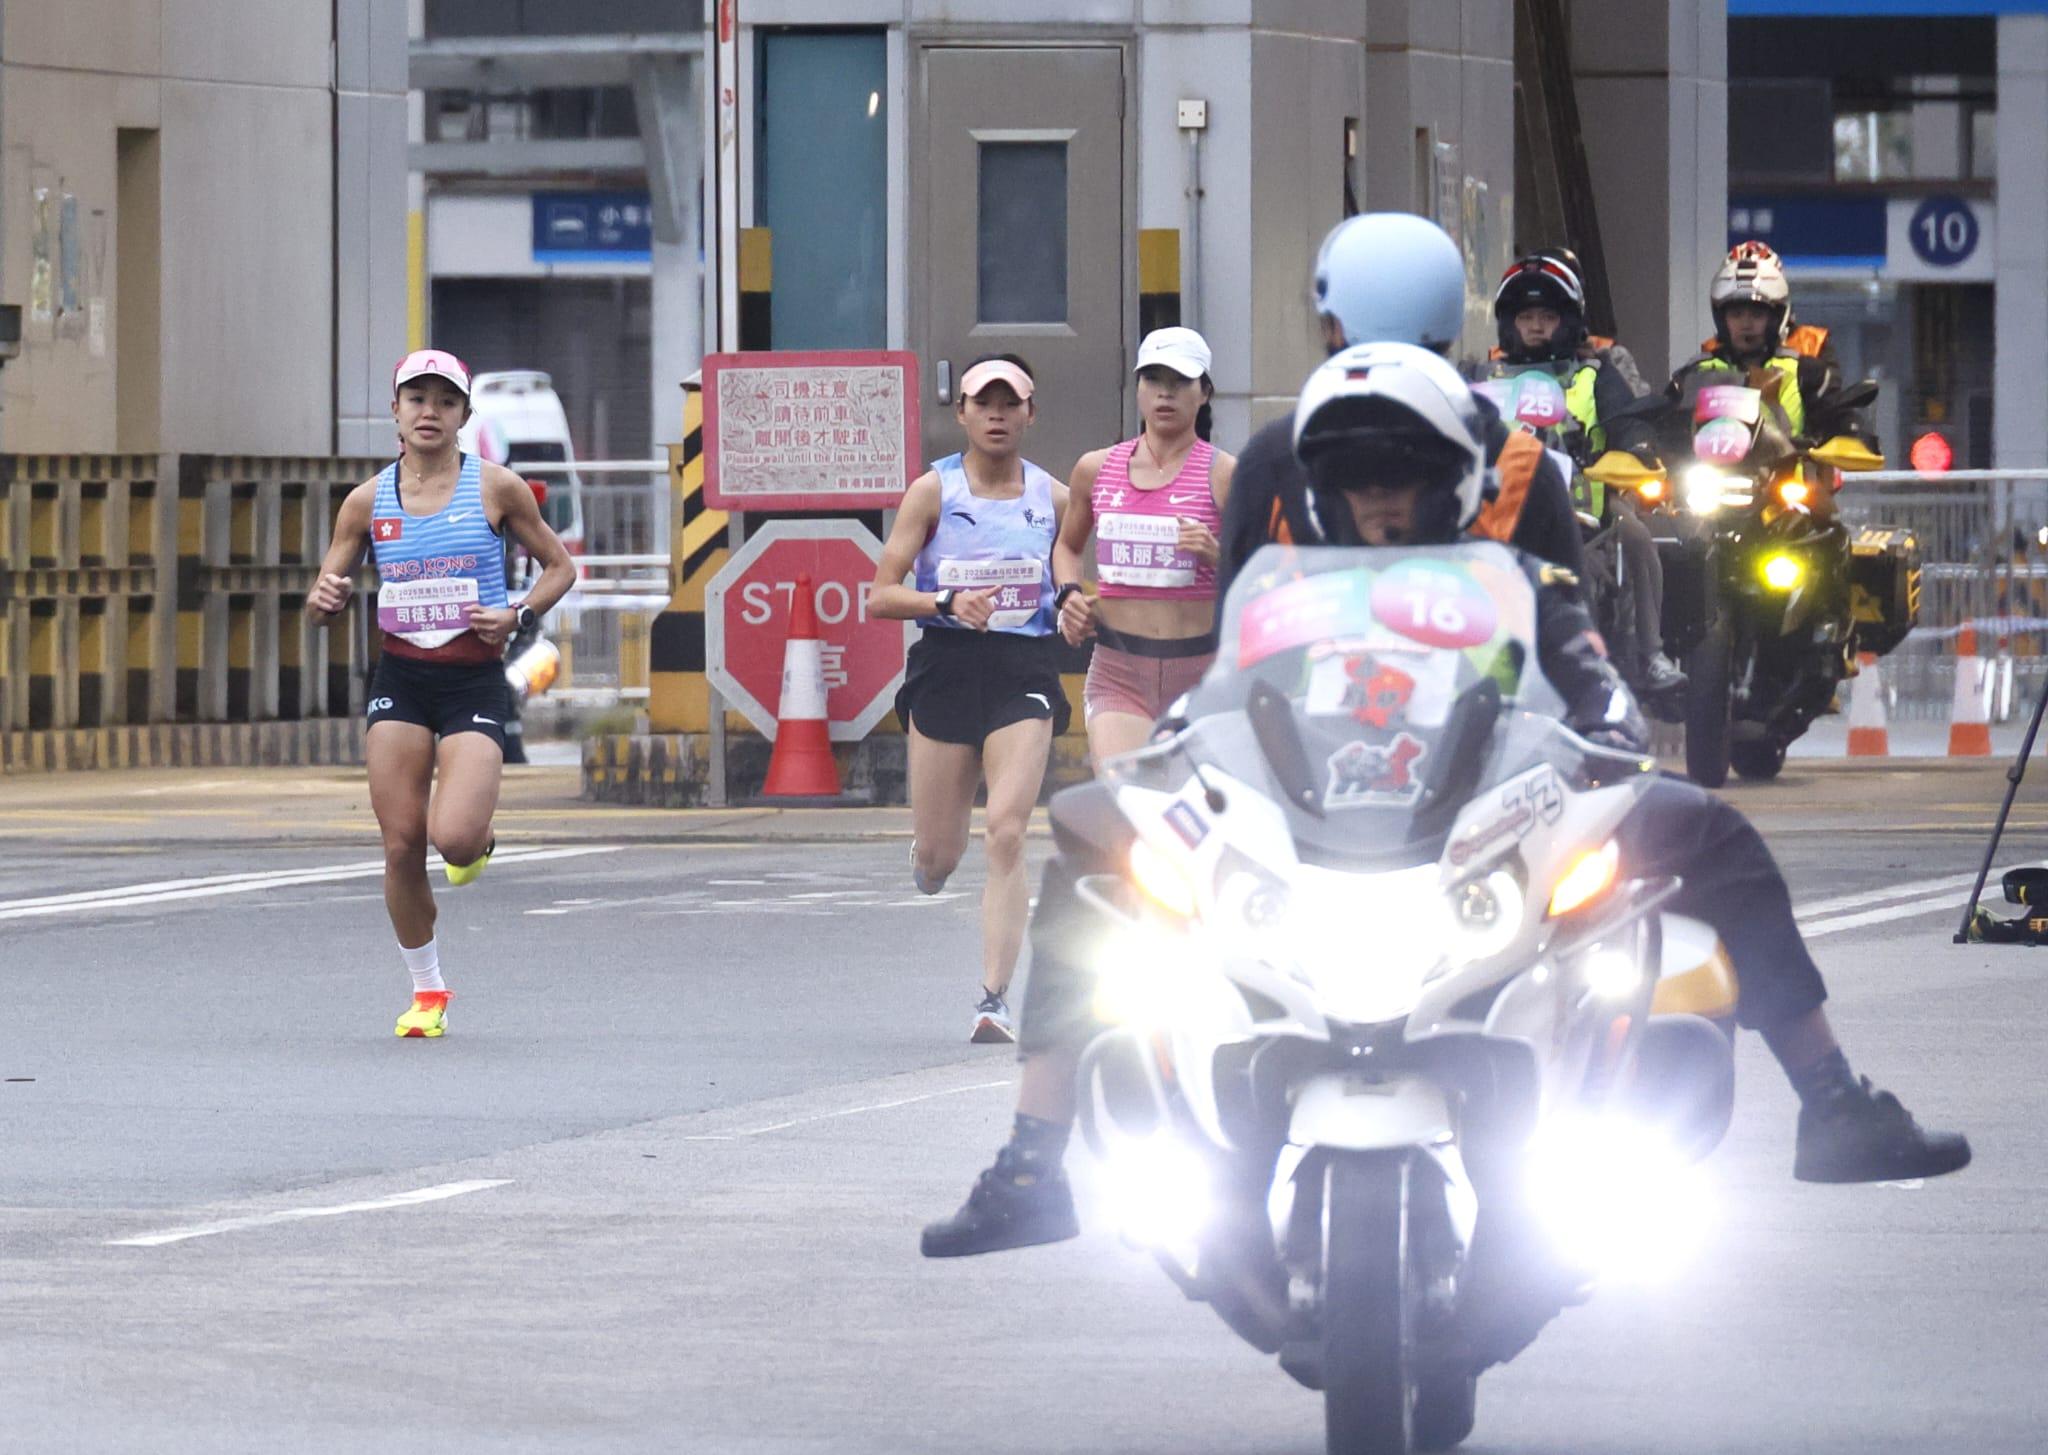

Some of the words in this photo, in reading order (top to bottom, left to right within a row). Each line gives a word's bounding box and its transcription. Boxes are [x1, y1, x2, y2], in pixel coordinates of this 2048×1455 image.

[1919, 212, 1968, 253] 10
[774, 380, 849, 400] 司機注意
[774, 405, 851, 423] 請待前車
[1520, 394, 1553, 416] 25
[754, 429, 870, 448] 離開後才駛進
[1711, 435, 1736, 455] 17
[725, 452, 761, 465] Please
[763, 452, 786, 465] wait
[787, 452, 812, 465] until
[813, 452, 831, 465] the
[833, 452, 856, 465] lane
[858, 452, 868, 465] is
[870, 452, 897, 465] clear
[424, 554, 477, 573] KONG
[1112, 542, 1175, 567] 陈丽琴
[1177, 560, 1193, 568] 202
[396, 604, 461, 623] 司徒兆殷
[1403, 593, 1467, 632] 16
[420, 623, 437, 631] 204
